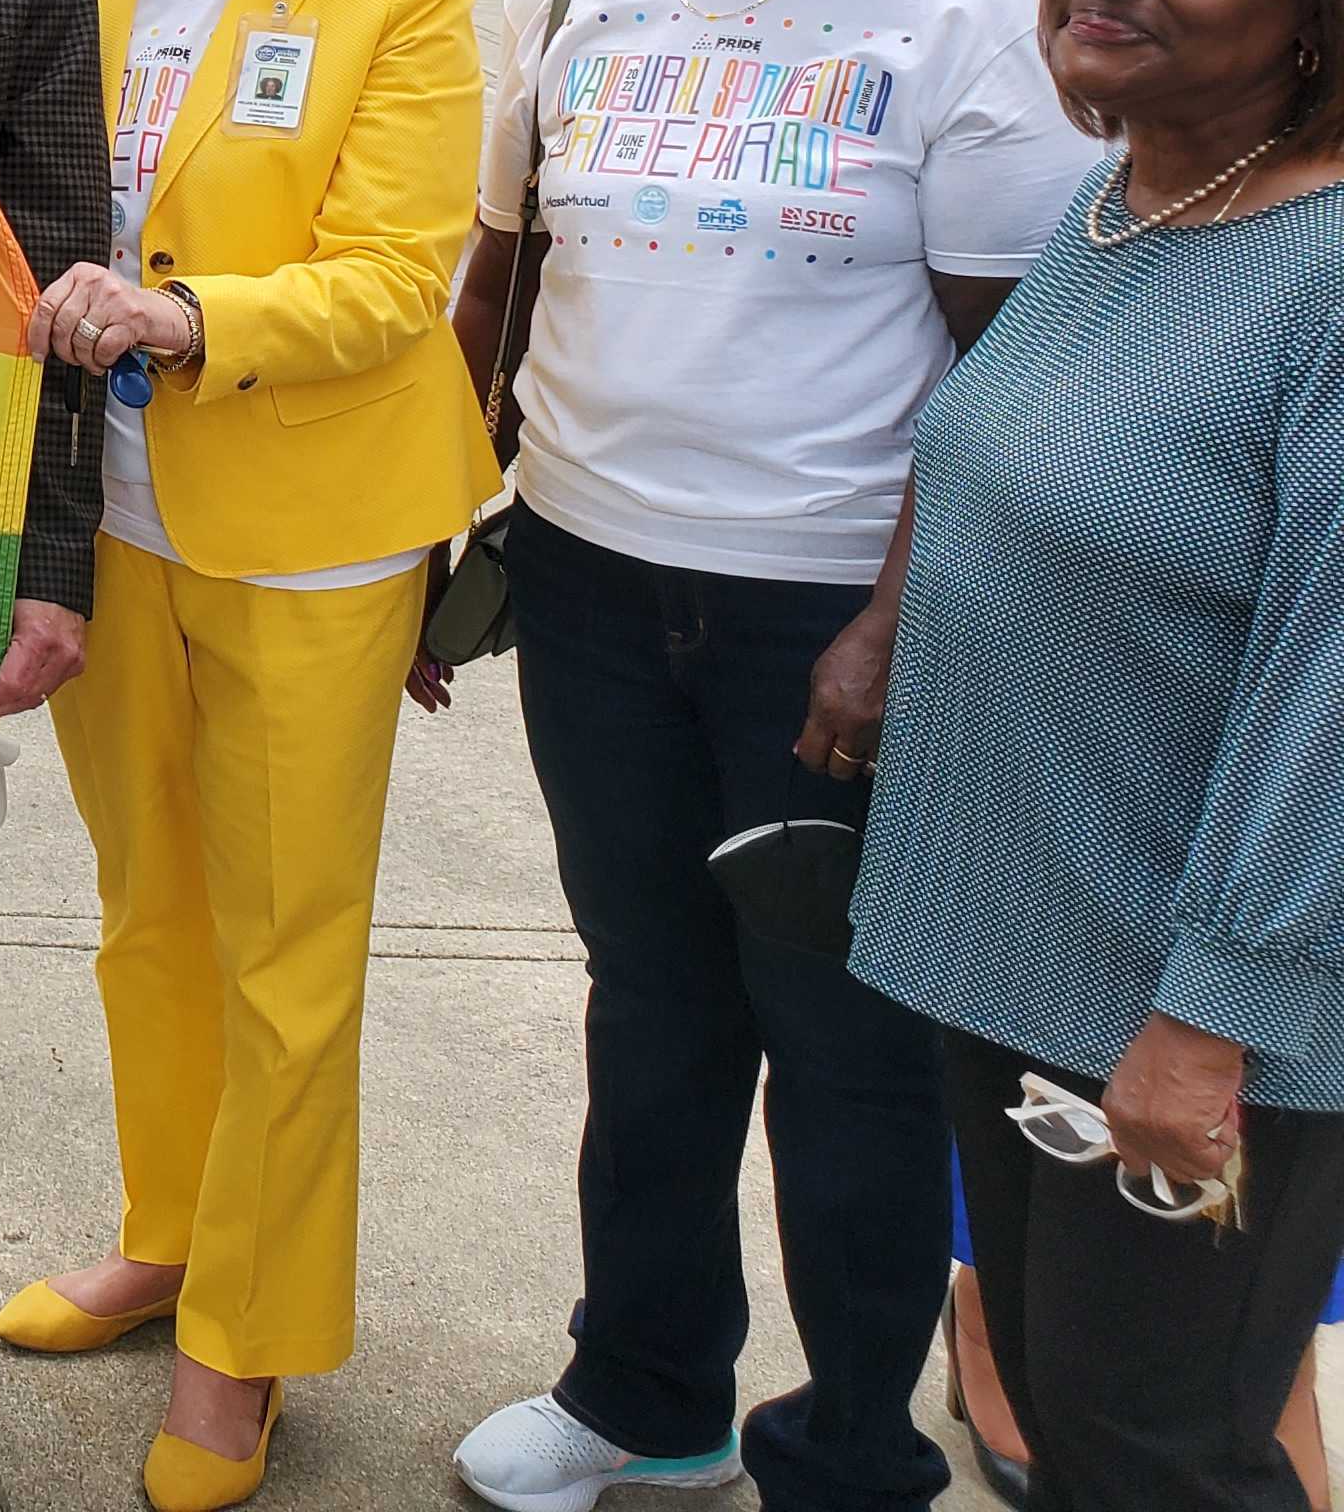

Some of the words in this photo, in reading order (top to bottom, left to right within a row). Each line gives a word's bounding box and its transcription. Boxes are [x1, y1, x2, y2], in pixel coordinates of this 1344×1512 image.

[715, 37, 762, 51] PRIDE
[625, 68, 639, 80] 20
[621, 80, 637, 92] 22
[556, 55, 711, 118] INAUGURAL
[711, 57, 894, 136] SPRINGFIELD
[856, 78, 876, 116] SATURDAY
[614, 133, 647, 148] JUNE
[615, 147, 639, 160] 4TH
[687, 119, 876, 198] PARADE
[698, 210, 748, 226] DHHS
[803, 209, 857, 233] STCC
